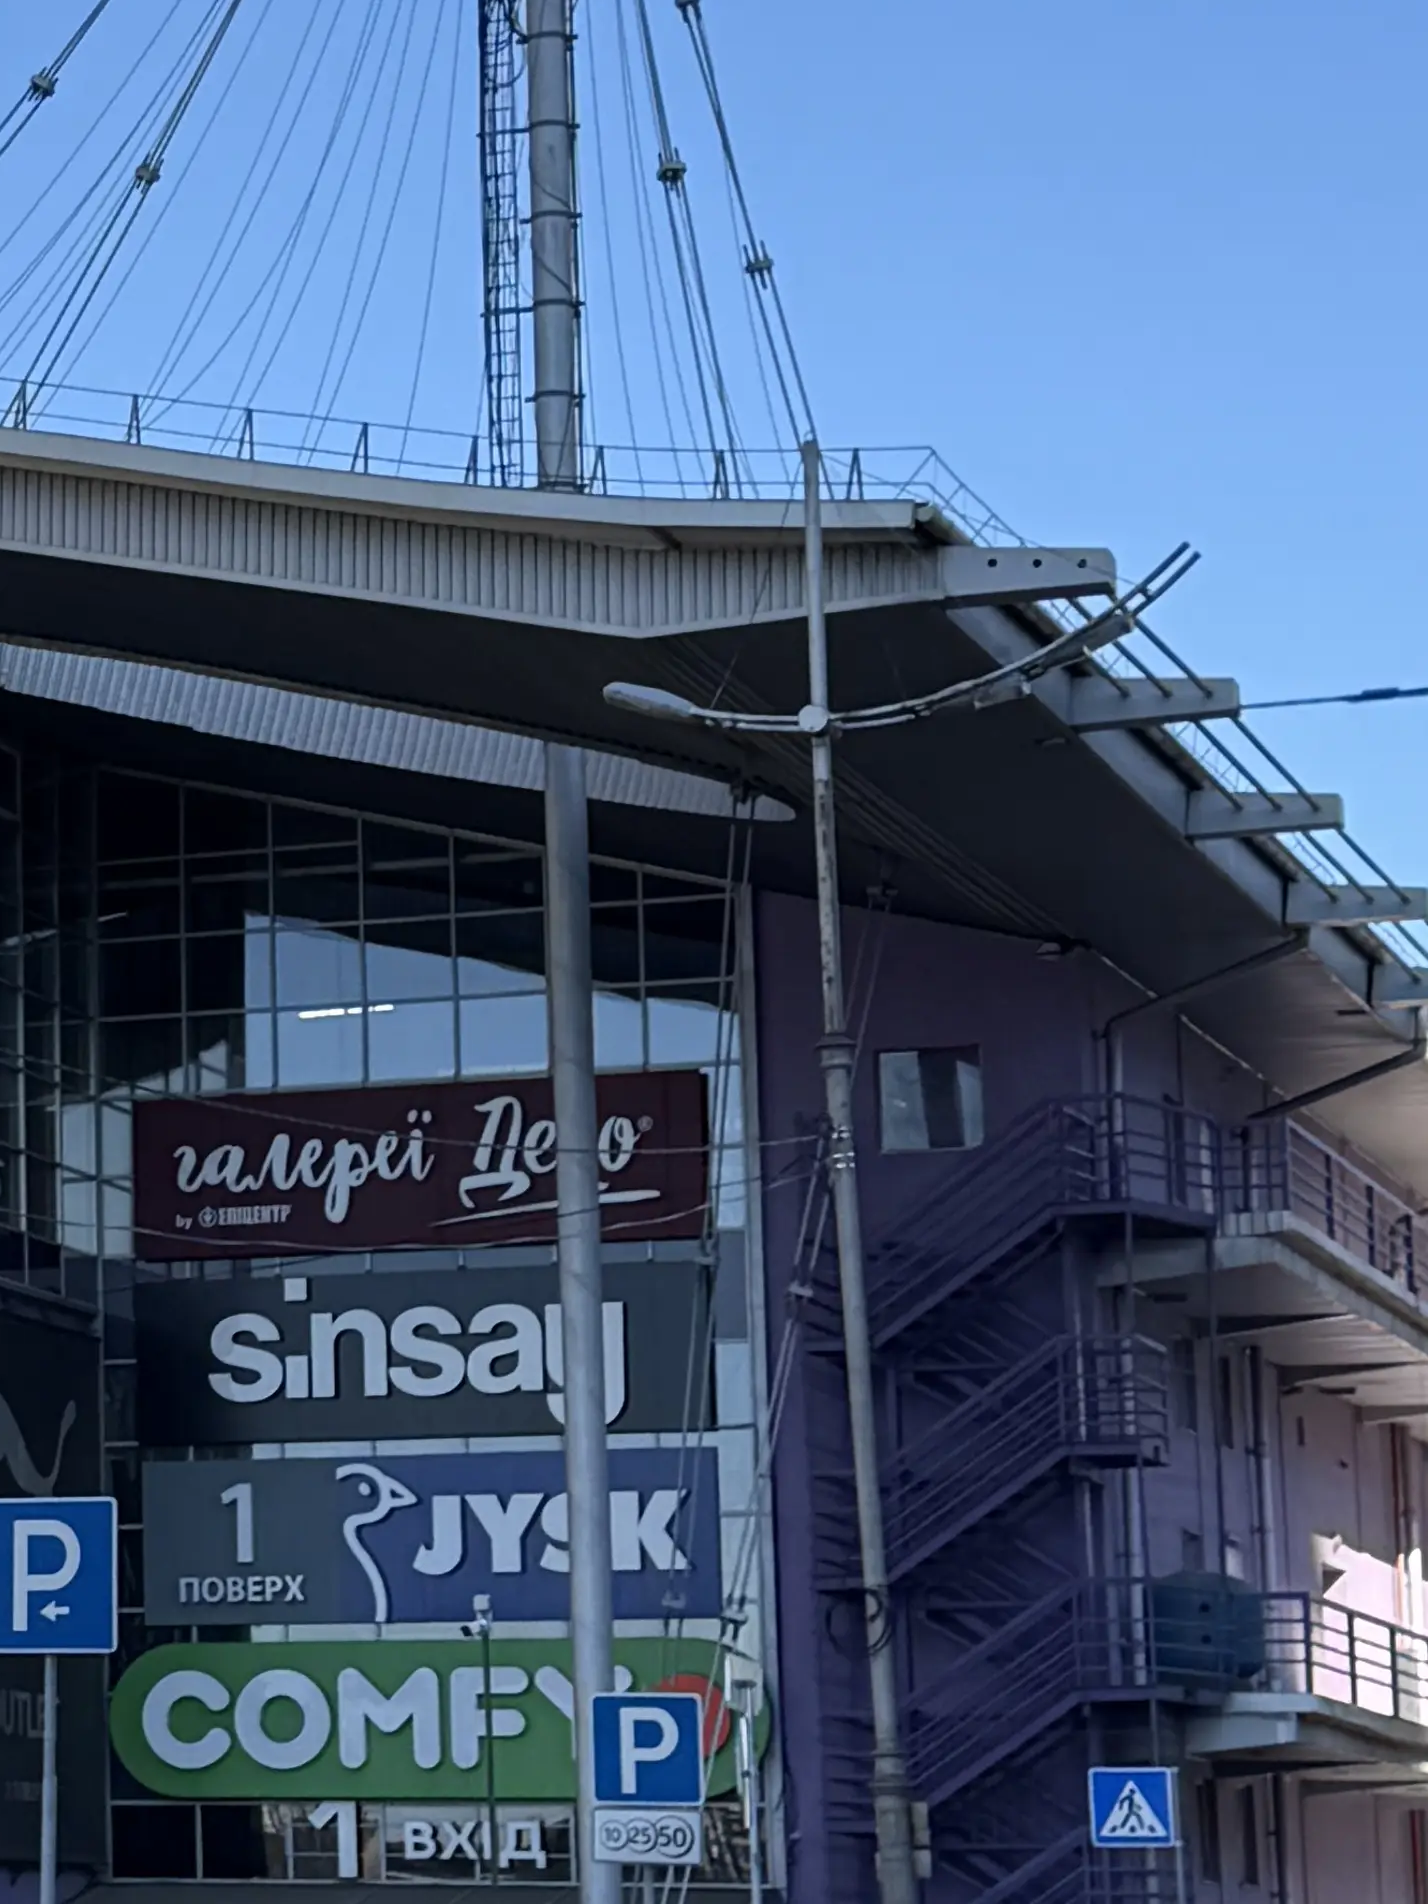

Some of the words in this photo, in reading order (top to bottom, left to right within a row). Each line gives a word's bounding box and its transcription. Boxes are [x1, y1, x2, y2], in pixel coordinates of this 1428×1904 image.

[173, 1110, 436, 1222] галереї
[459, 1096, 640, 1208] Део
[220, 1483, 254, 1563] 1
[12, 1519, 81, 1632] P
[178, 1573, 305, 1603] ПОВЕРХ
[619, 1706, 679, 1794] P
[308, 1800, 358, 1878] 1
[405, 1820, 547, 1869] ВХІД
[659, 1826, 687, 1847] 50
